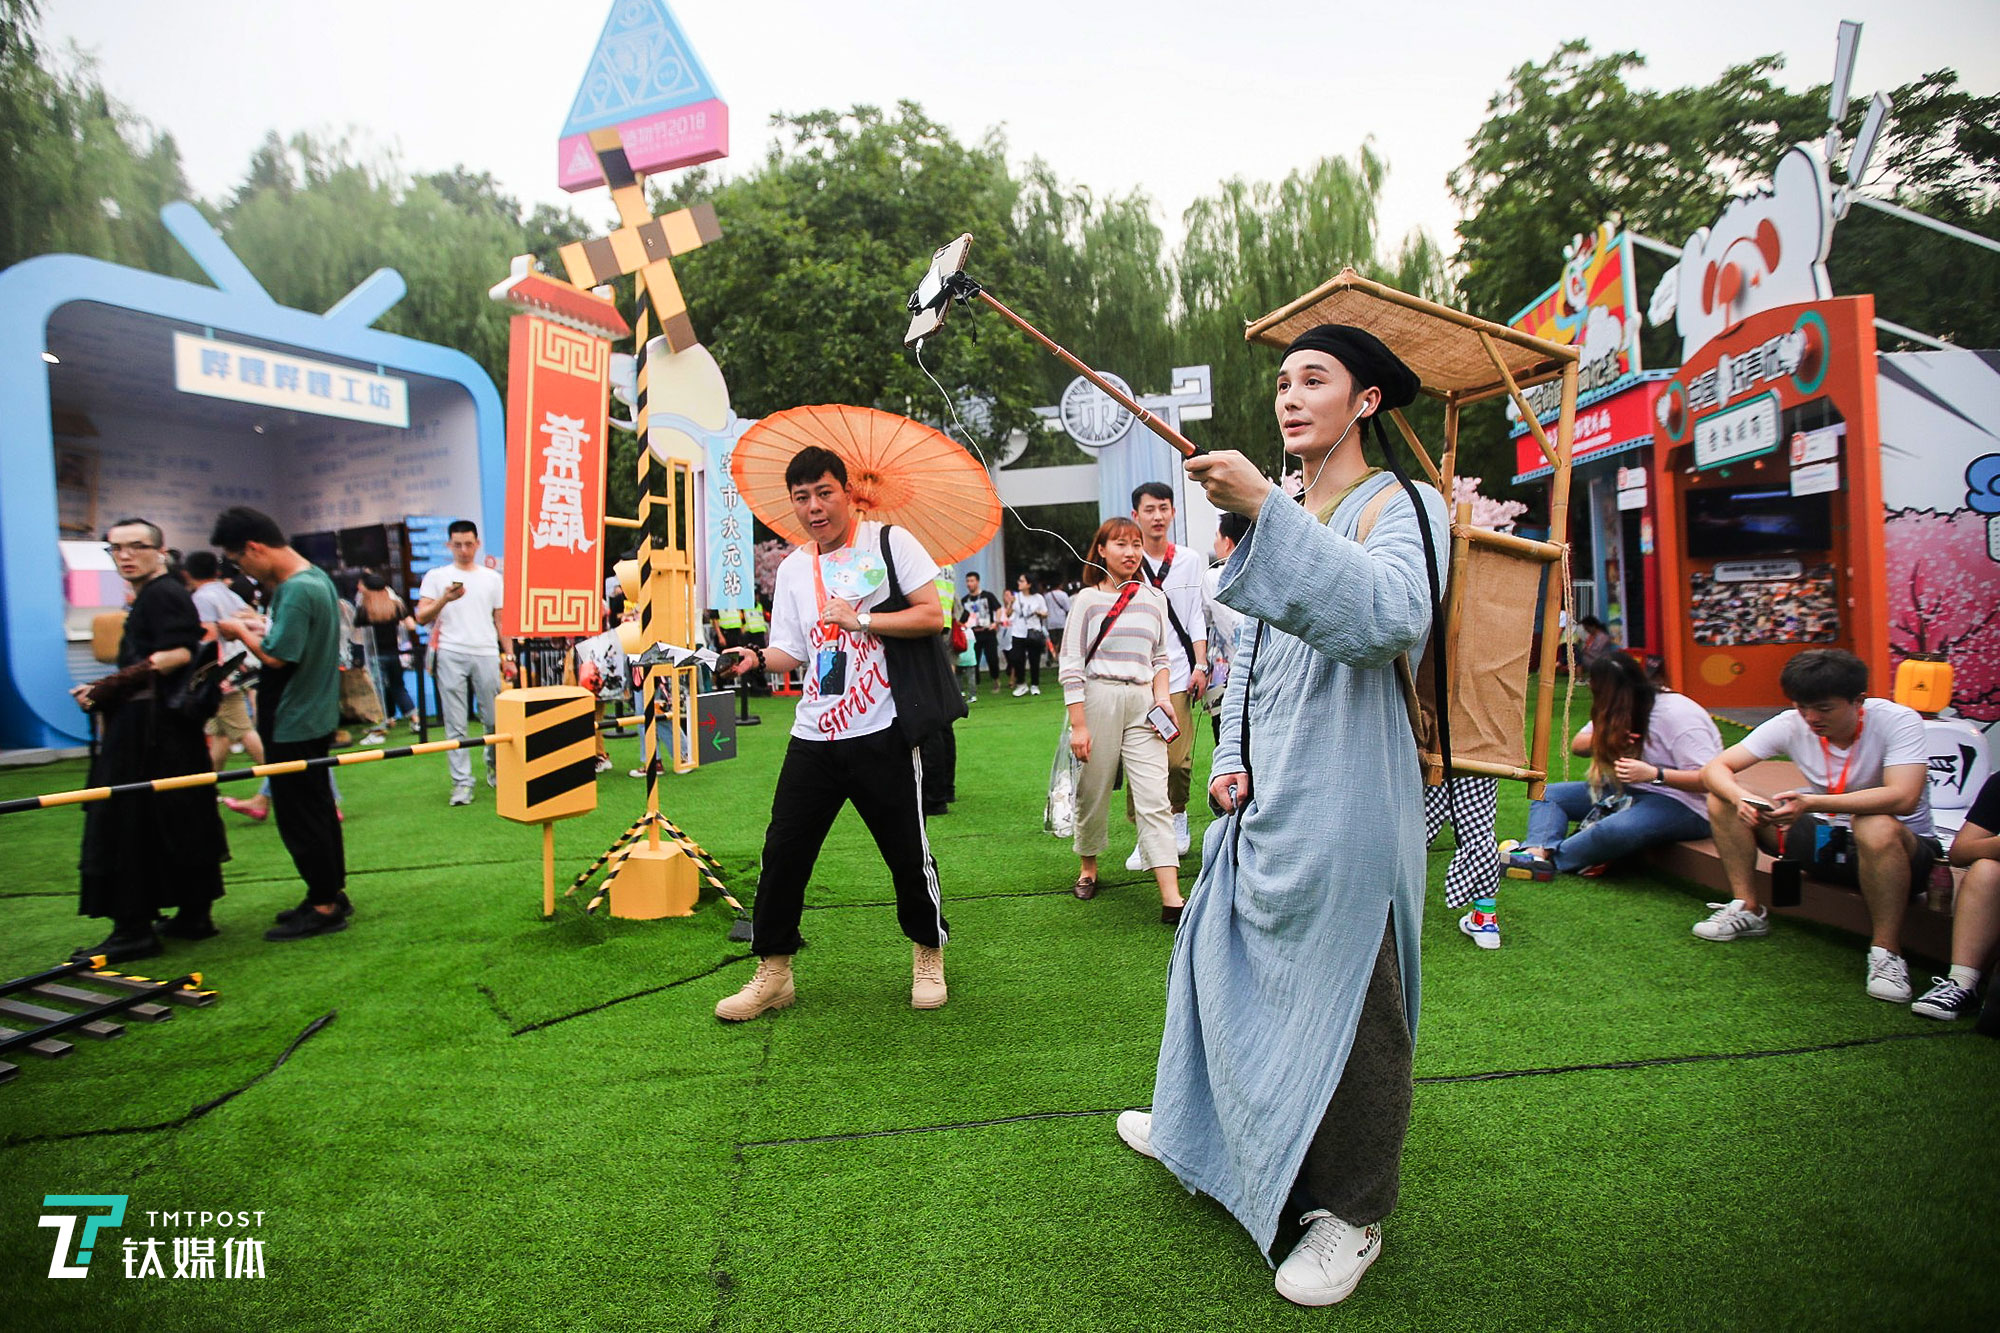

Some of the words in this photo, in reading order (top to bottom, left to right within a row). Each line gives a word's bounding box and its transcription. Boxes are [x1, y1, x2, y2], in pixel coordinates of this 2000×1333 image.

[720, 451, 742, 596] 宅市次元站
